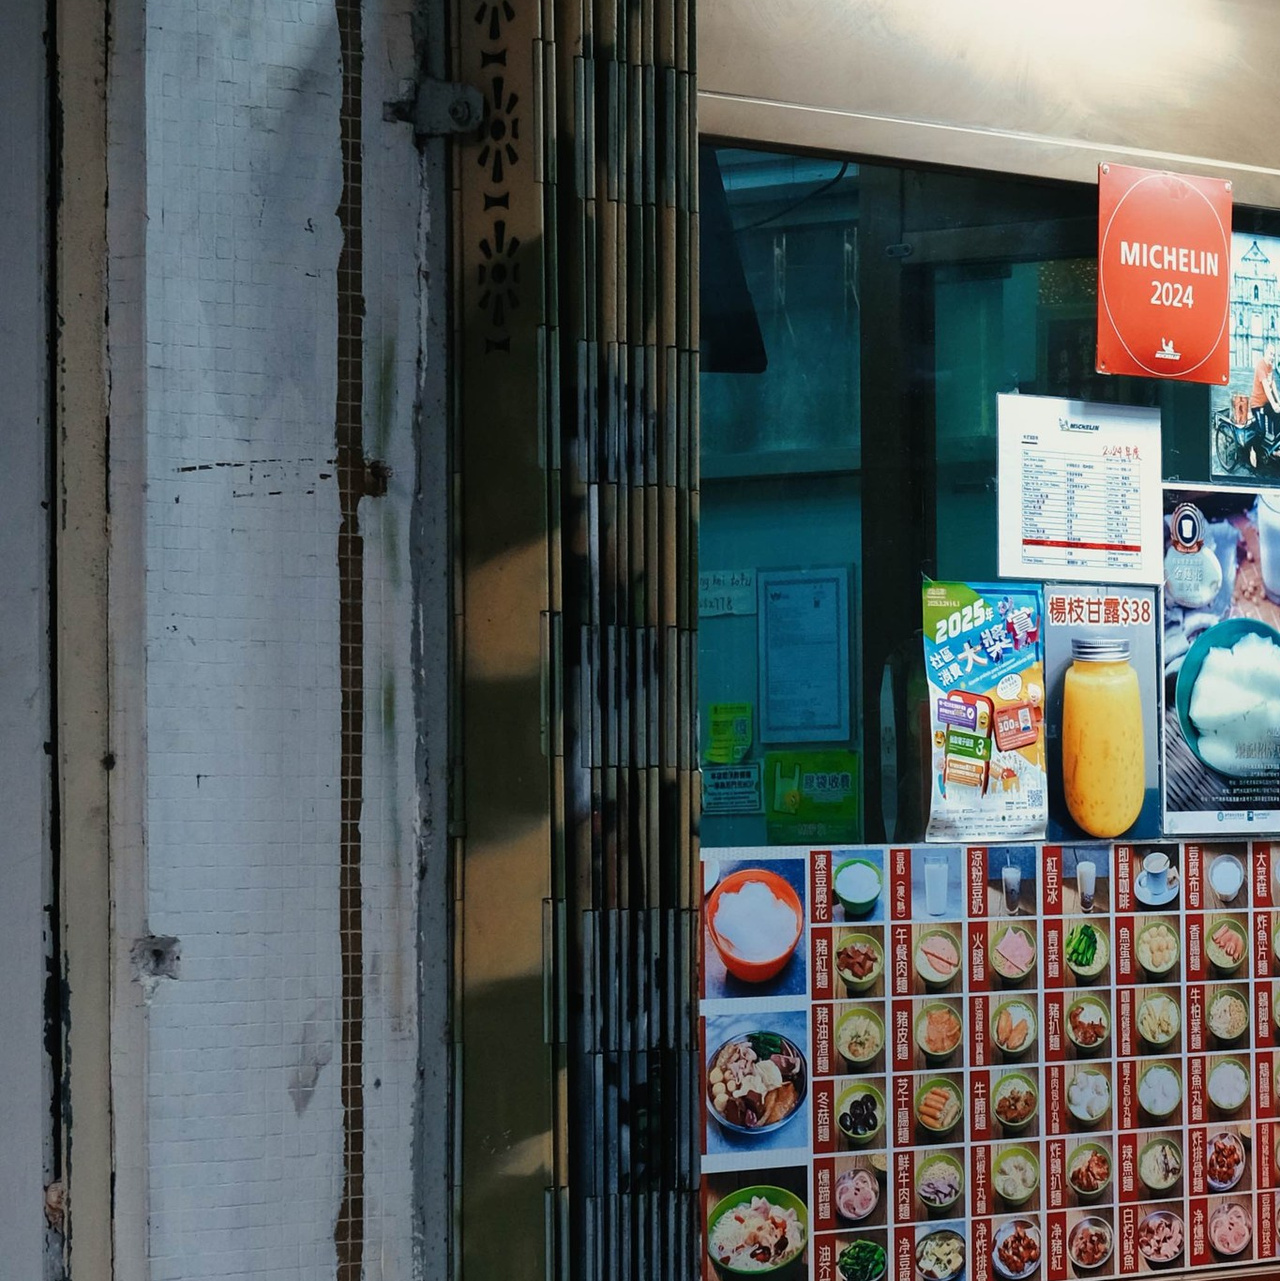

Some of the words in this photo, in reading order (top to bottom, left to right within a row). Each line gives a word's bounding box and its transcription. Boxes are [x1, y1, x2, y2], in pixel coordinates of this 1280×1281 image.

[1120, 241, 1219, 277] MICHELIN
[1150, 281, 1194, 309] 2024
[1070, 423, 1100, 431] MICHELIN
